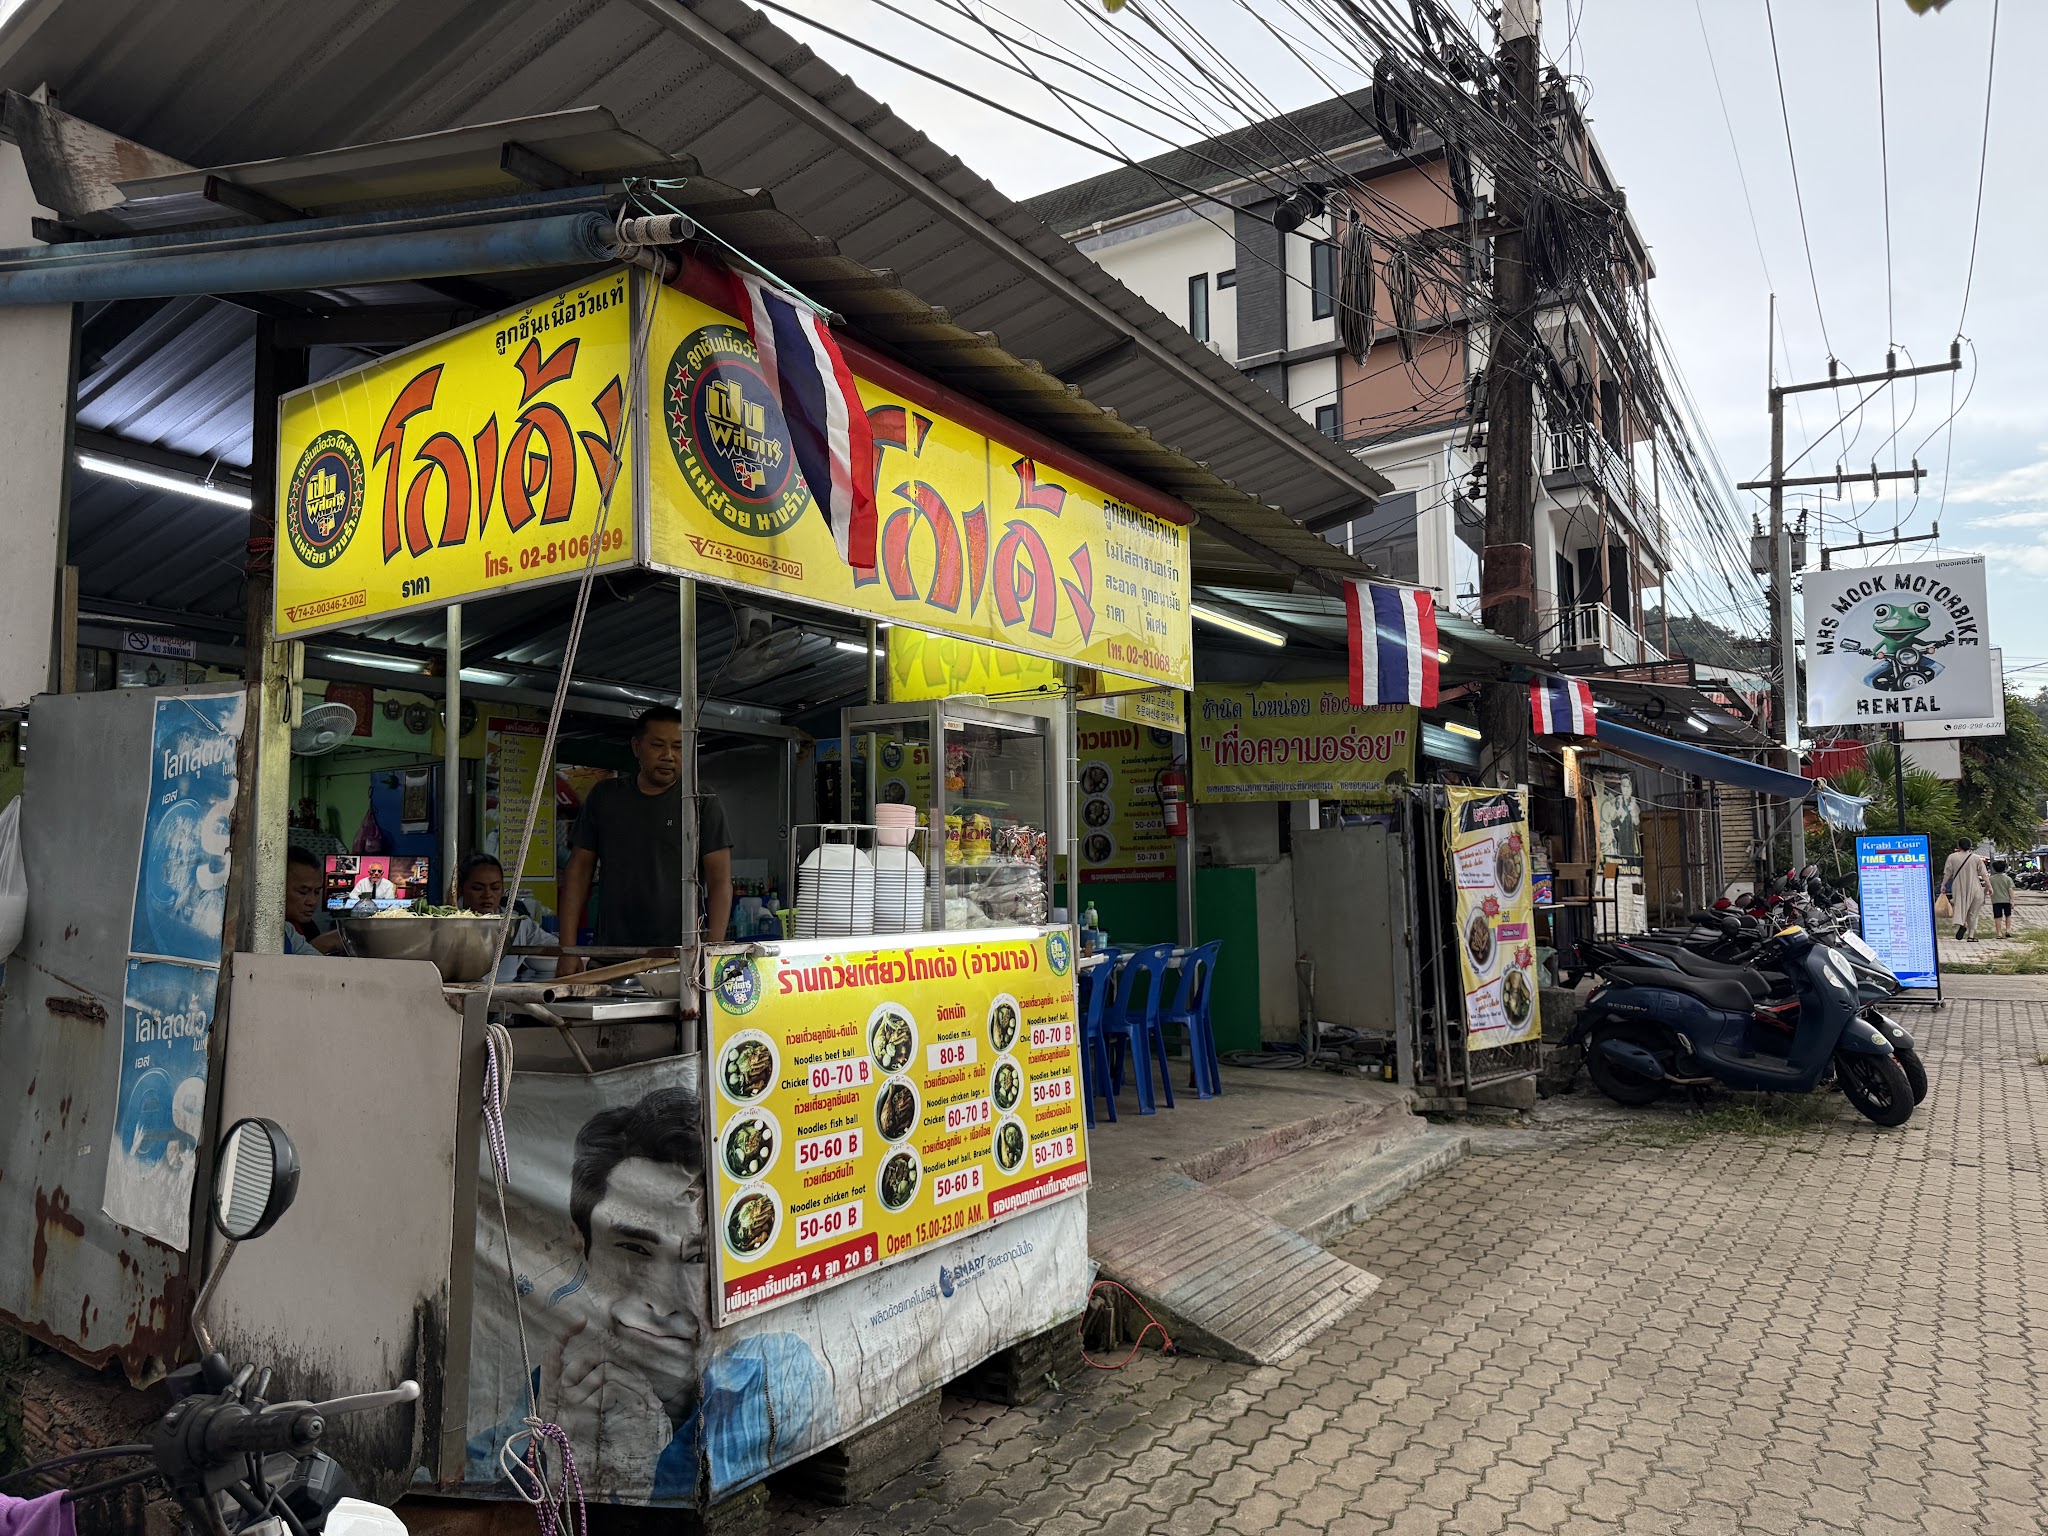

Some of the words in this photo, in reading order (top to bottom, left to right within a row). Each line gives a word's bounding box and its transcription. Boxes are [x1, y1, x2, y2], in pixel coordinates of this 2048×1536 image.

[495, 277, 624, 356] ลูกชิ้นเนื้อวัวแท้
[485, 550, 513, 579] โทร.
[402, 575, 430, 599] ราคา
[1105, 574, 1137, 598] สะอาด
[1105, 604, 1126, 624] ราคา
[1146, 611, 1167, 636] พิเศษ
[1816, 616, 1840, 656] MRS
[1830, 574, 1887, 616] MOOK
[1893, 573, 1979, 647] MOTORBIKE
[152, 645, 161, 654] NO
[163, 645, 191, 657] SMOKING
[1107, 638, 1125, 662] โทร.
[1246, 691, 1311, 718] ไวหน่อย
[1856, 695, 1942, 716] RENTAL
[1200, 723, 1407, 767] "เพื่อความอร่อย"
[1863, 841, 1892, 850] Krabi
[1895, 840, 1921, 850] Tour
[1861, 855, 1886, 864] TIME
[1891, 853, 1926, 864] TABLE
[936, 1003, 966, 1022] จัดหนัก
[1026, 1016, 1047, 1026] Noodles
[1047, 1013, 1059, 1022] beef
[937, 1033, 960, 1042] Noodles
[961, 1028, 971, 1037] mix
[1033, 1027, 1061, 1046] 60-70
[794, 1055, 823, 1066] Noodles
[825, 1052, 840, 1061] beef
[842, 1048, 855, 1057] ball
[812, 1063, 853, 1089] 60-70
[1029, 1072, 1049, 1082] Noodles
[1050, 1069, 1061, 1078] beef
[1061, 1065, 1072, 1074] ball
[926, 1096, 949, 1108] Noodles
[950, 1091, 970, 1103] chicken
[1033, 1082, 1061, 1101] 50-60
[797, 1122, 827, 1136] Noodles
[830, 1116, 843, 1128] fish
[845, 1113, 859, 1125] ball
[923, 1114, 945, 1126] Chicken
[948, 1104, 978, 1128] 60-70
[1030, 1131, 1050, 1142] Noodles
[1050, 1125, 1069, 1137] chicken
[800, 1137, 842, 1164] 50-60
[923, 1161, 946, 1174] Noodles
[947, 1155, 960, 1167] beef
[973, 1146, 992, 1159] Braised
[1035, 1140, 1063, 1164] 50-70
[937, 1173, 968, 1198] 50-60
[790, 1199, 821, 1214] Noodles
[823, 1190, 849, 1205] chicken
[851, 1184, 866, 1197] foot
[800, 1211, 842, 1240] 50-60
[886, 1229, 912, 1254] Open
[915, 1211, 965, 1244] 15.00-23.00
[967, 1203, 984, 1223] AM.
[811, 1265, 821, 1281] 4
[825, 1259, 841, 1279] ลูก
[844, 1250, 860, 1267] 20
[953, 1254, 987, 1282] SMART
